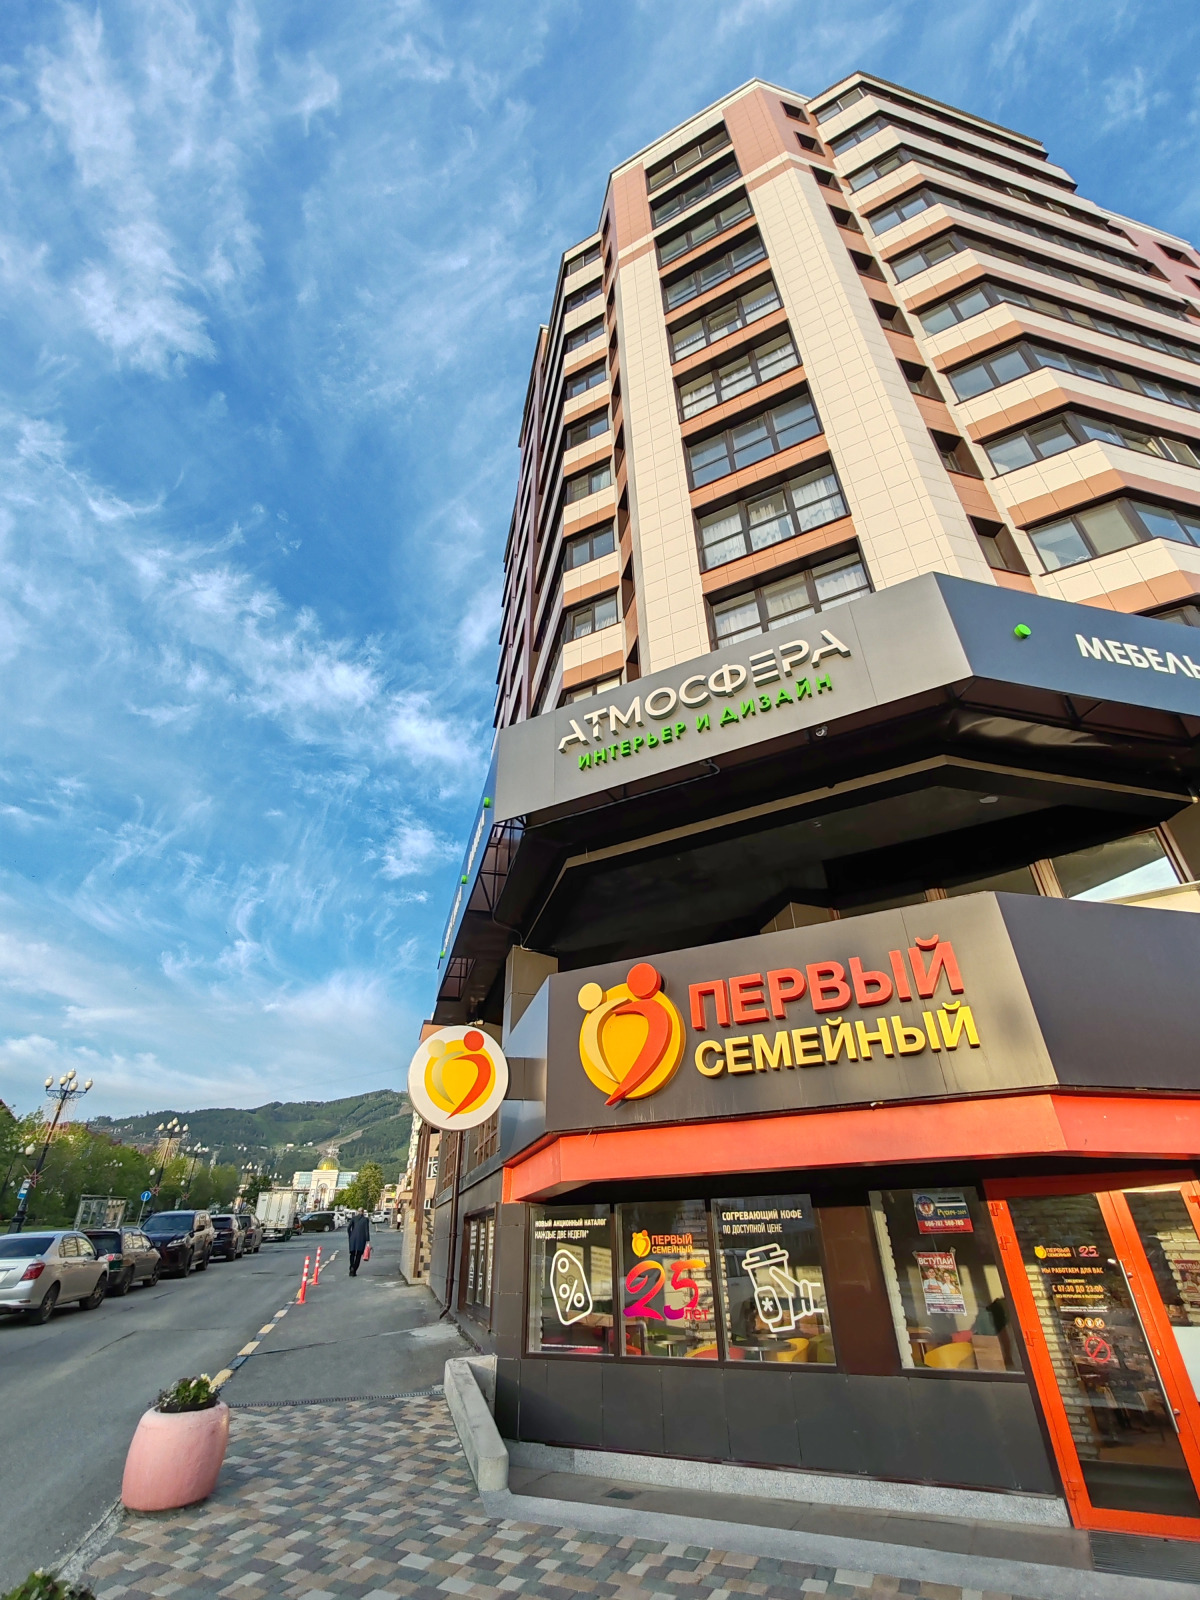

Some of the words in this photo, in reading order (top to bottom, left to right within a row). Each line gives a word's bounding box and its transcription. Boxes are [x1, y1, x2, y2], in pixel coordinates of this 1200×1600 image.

[557, 629, 852, 754] АТМОСФЕРА
[578, 721, 687, 771] ИНТЕРЬЕР
[696, 713, 711, 732] И
[719, 673, 833, 728] ДИЗАЙН
[688, 934, 965, 1031] ПЕРВЫЙ
[694, 1000, 981, 1079] СЕМЕЙНЫЙ
[722, 1209, 779, 1221] СОГРЕВАЮЩИЙ
[781, 1209, 803, 1219] КОФЕ
[535, 1219, 552, 1227] НОВЫЙ
[553, 1218, 583, 1228] АКЦИОННЫЙ
[584, 1218, 607, 1226] КАТАЛОГ
[723, 1224, 731, 1234] ПО
[732, 1223, 766, 1235] ДОСТУПНОЙ
[767, 1224, 783, 1234] ЦЕНЕ
[535, 1230, 556, 1240] КАЖДЫЕ
[557, 1230, 567, 1239] ДВЕ
[651, 1233, 693, 1245] ПЕРВЫЙ
[651, 1245, 693, 1254] СЕМЕЙНЫЙ
[918, 1256, 954, 1265] ВСТУПАЙ
[623, 1259, 707, 1321] 25
[684, 1308, 710, 1320] лет
